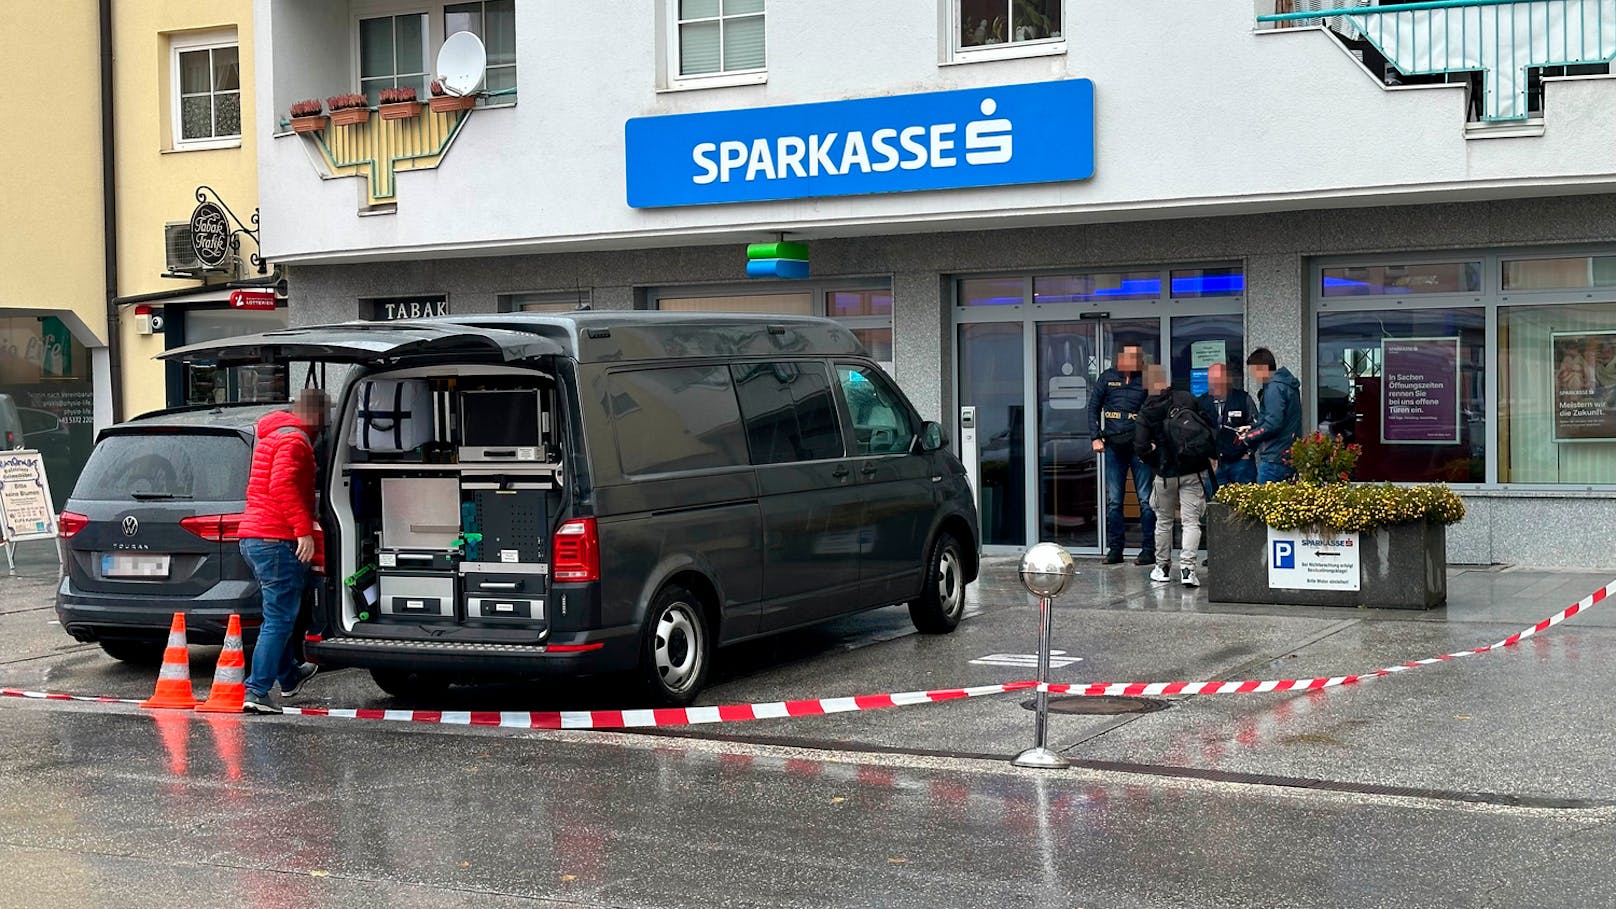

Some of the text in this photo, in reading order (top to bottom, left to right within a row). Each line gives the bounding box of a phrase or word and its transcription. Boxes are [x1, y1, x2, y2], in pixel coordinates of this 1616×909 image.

[692, 122, 957, 184] SPARKASSE
[195, 212, 225, 235] Tabak
[385, 301, 447, 319] TABAK
[1388, 382, 1443, 390] Öffnungszeiten
[1559, 401, 1593, 409] Meistern
[1104, 411, 1122, 419] OLIZEI
[1559, 409, 1571, 417] die
[1276, 543, 1291, 567] P
